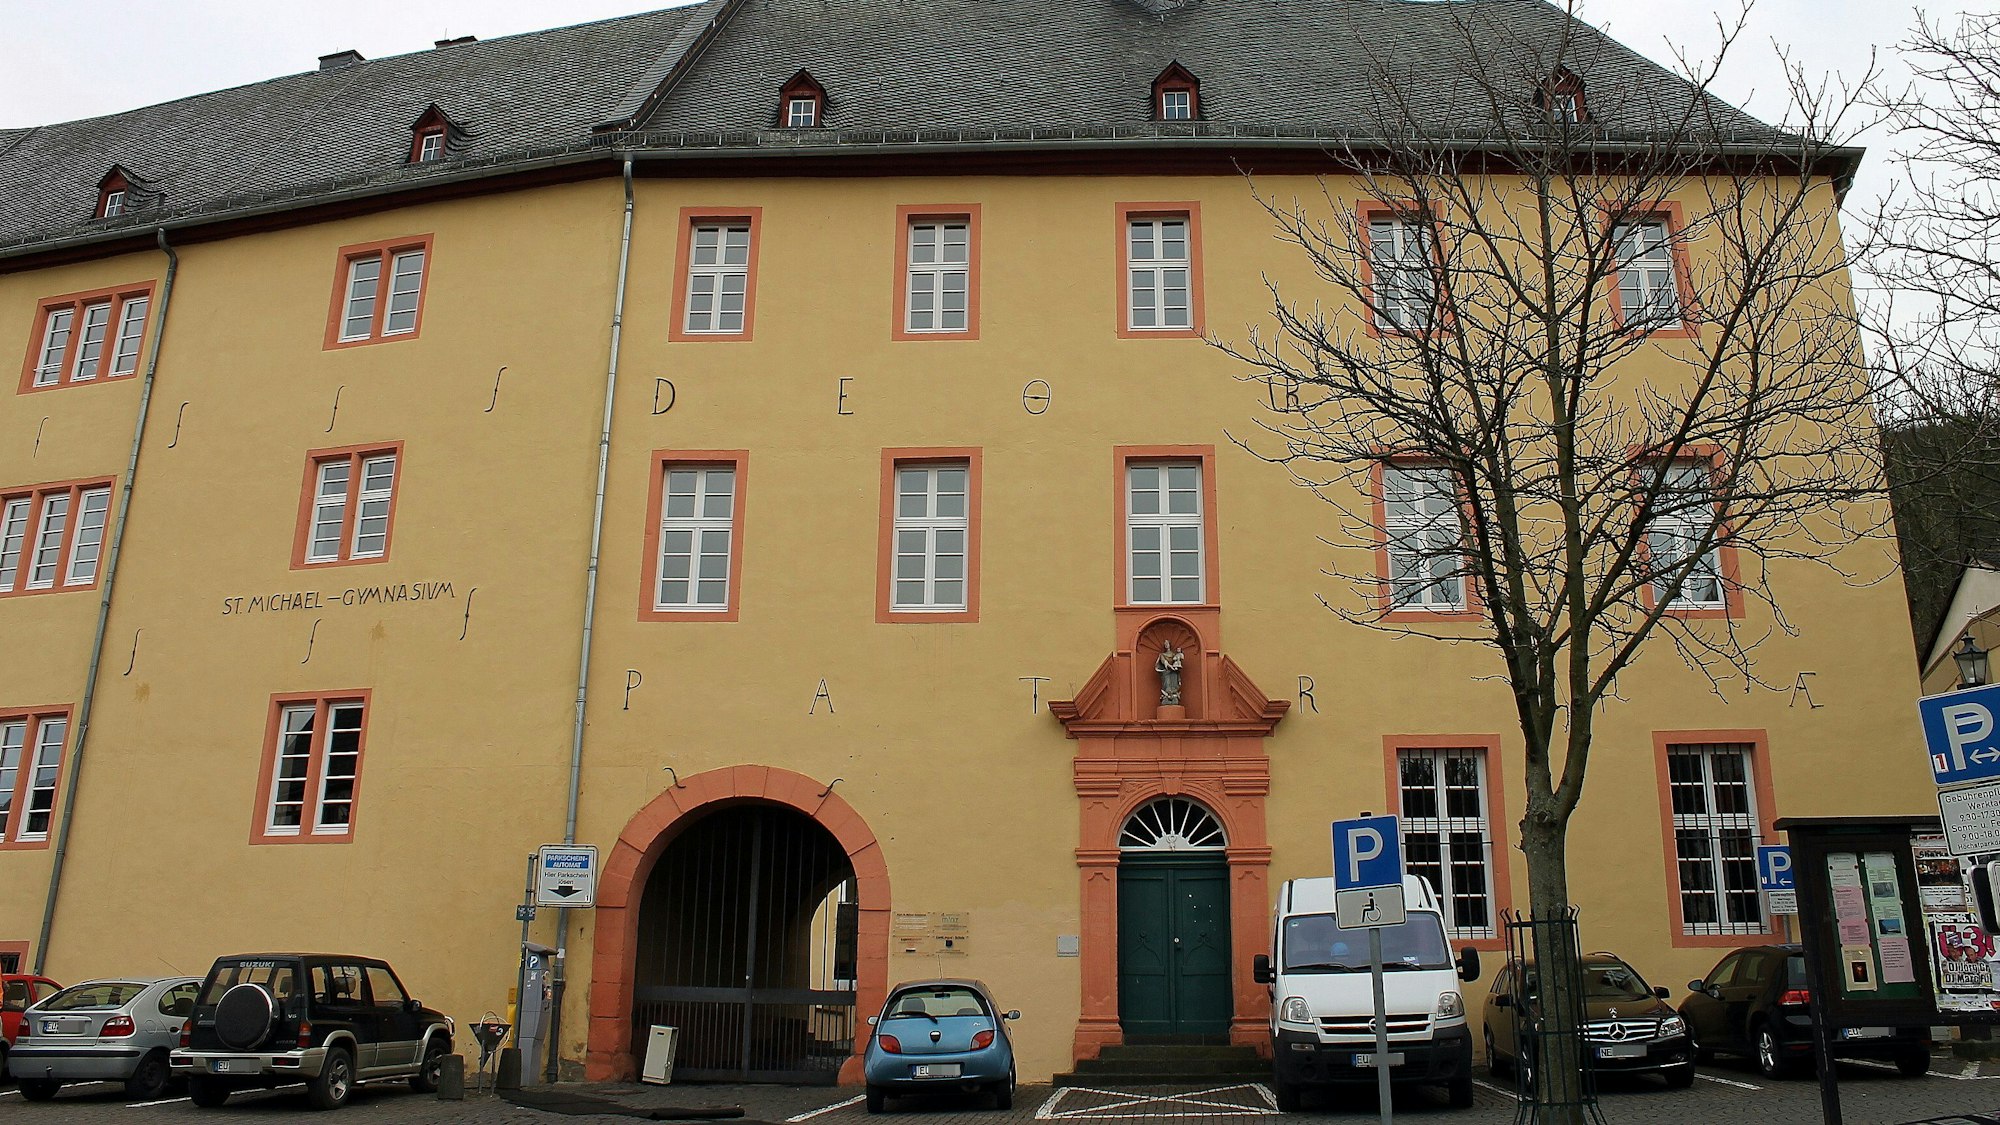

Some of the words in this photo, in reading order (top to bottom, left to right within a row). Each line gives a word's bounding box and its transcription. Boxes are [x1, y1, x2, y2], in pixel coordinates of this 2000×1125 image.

[651, 377, 676, 415] D
[837, 377, 854, 415] E
[222, 598, 243, 615] ST.
[623, 669, 642, 711] P
[809, 678, 835, 714] A
[1019, 677, 1051, 714] T
[1298, 675, 1319, 714] R
[1942, 703, 1993, 770] P
[1935, 754, 1946, 770] 1
[1967, 800, 2000, 810] Werkta
[547, 854, 588, 862] PARKSCHEIN-
[1348, 827, 1383, 882] P
[1768, 851, 1792, 884] P
